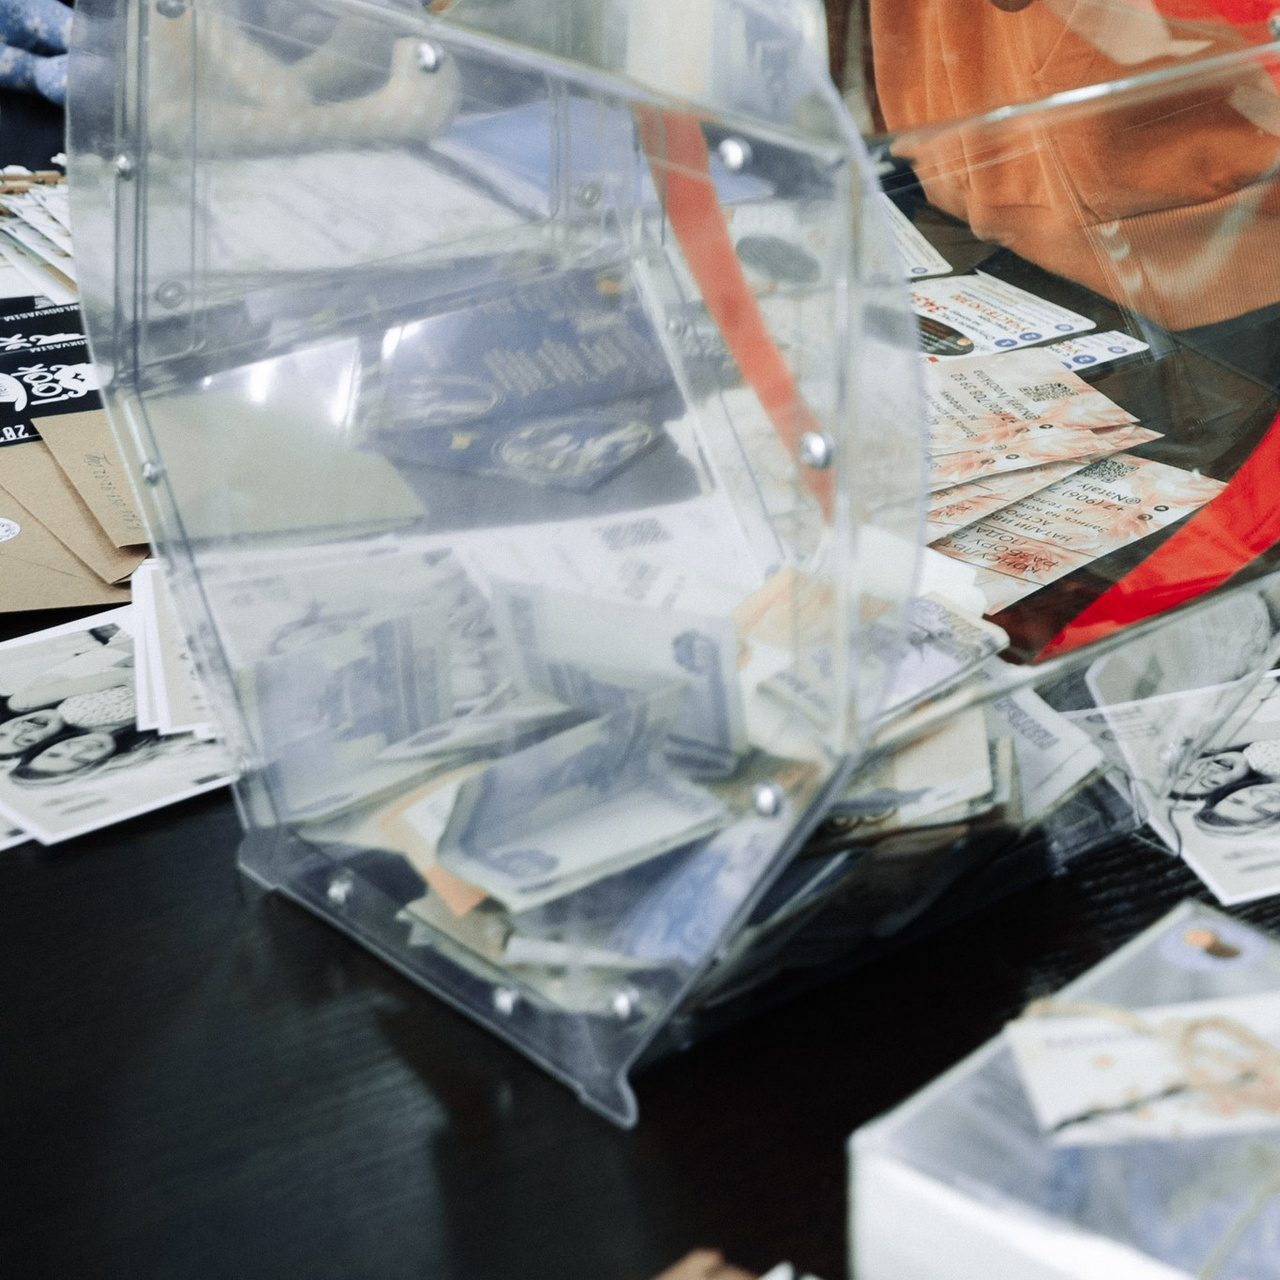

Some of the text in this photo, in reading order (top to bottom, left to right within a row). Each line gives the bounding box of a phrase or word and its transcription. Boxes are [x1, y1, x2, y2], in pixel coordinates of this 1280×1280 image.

[1058, 489, 1106, 506] (906)
[1012, 521, 1073, 542] НАТАЛИ
[1060, 516, 1109, 533] Запись
[967, 537, 1059, 567] РАЗБОРУ
